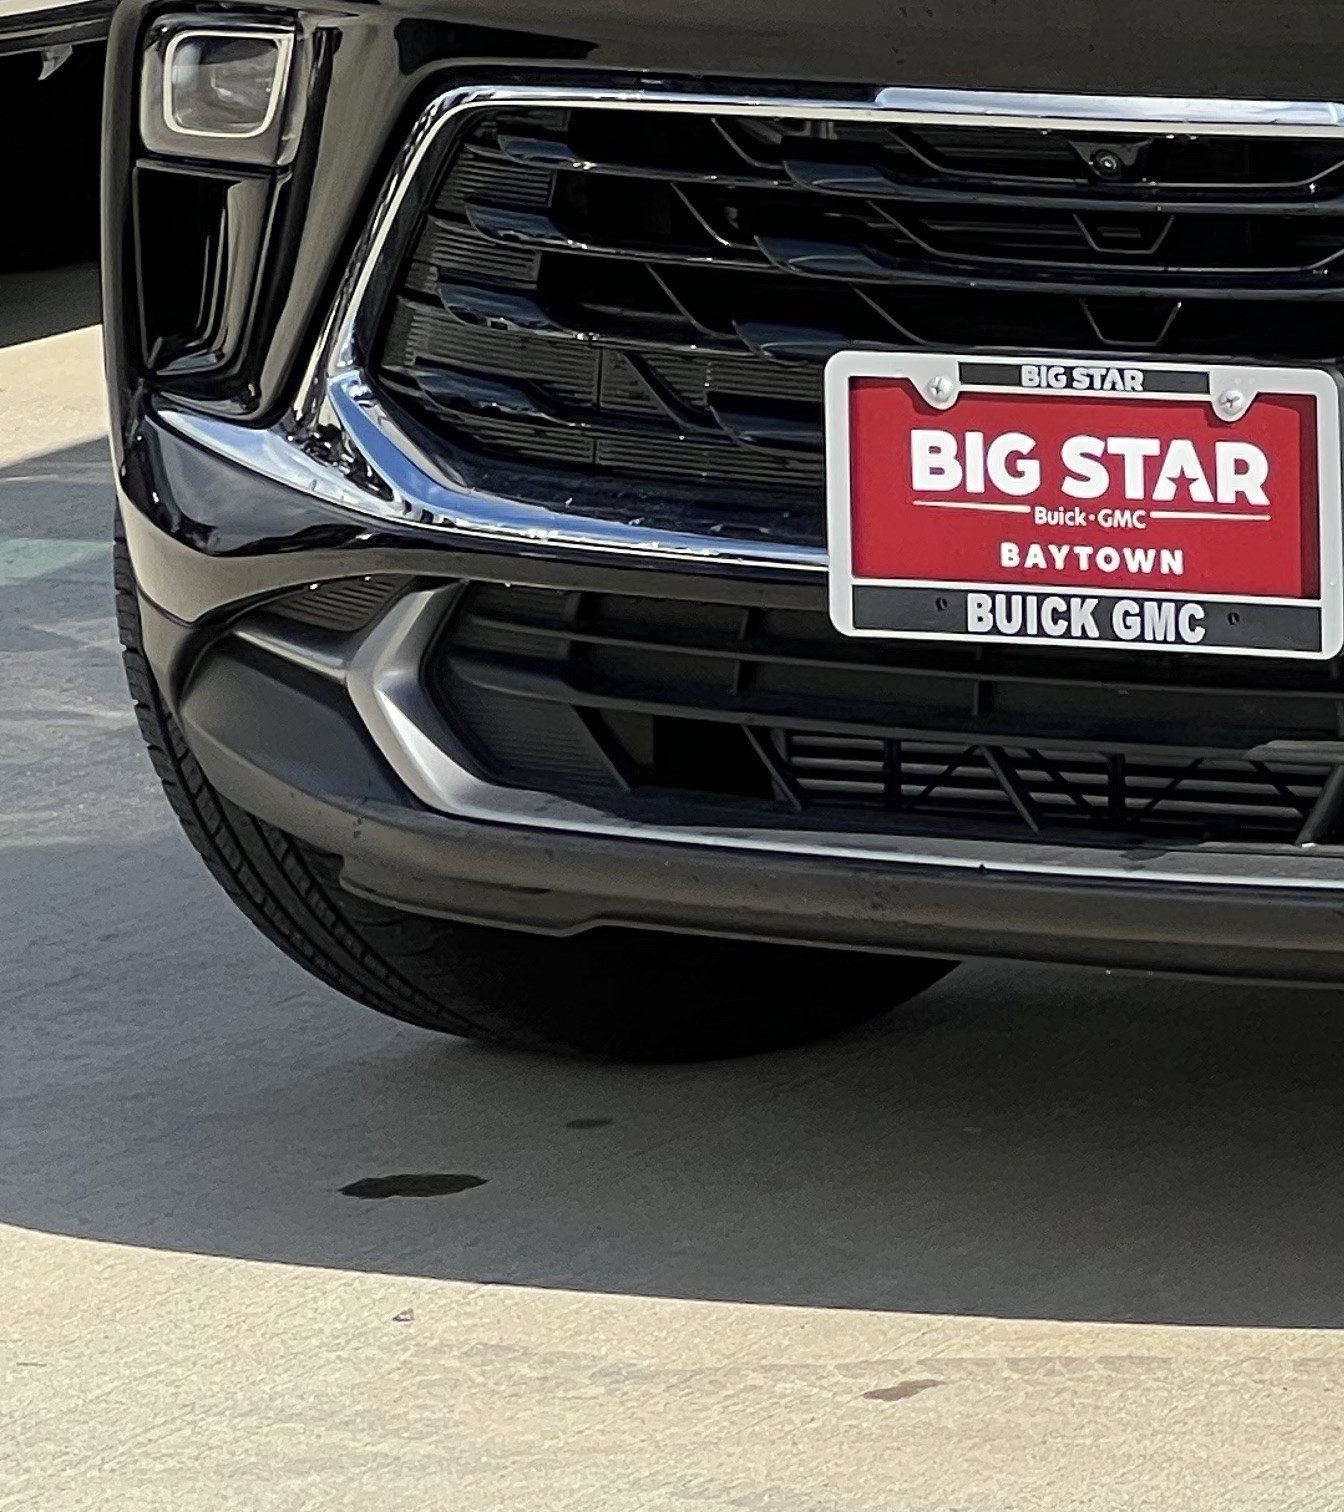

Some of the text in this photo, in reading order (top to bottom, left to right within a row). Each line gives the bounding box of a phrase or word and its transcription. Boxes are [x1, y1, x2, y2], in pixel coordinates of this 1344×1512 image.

[1020, 365, 1145, 392] BIG STAR
[908, 428, 1271, 507] BIG STAR
[1034, 505, 1147, 531] Buick GMC
[1000, 541, 1185, 576] BAYTOWN
[966, 593, 1206, 644] BUICK GMC
